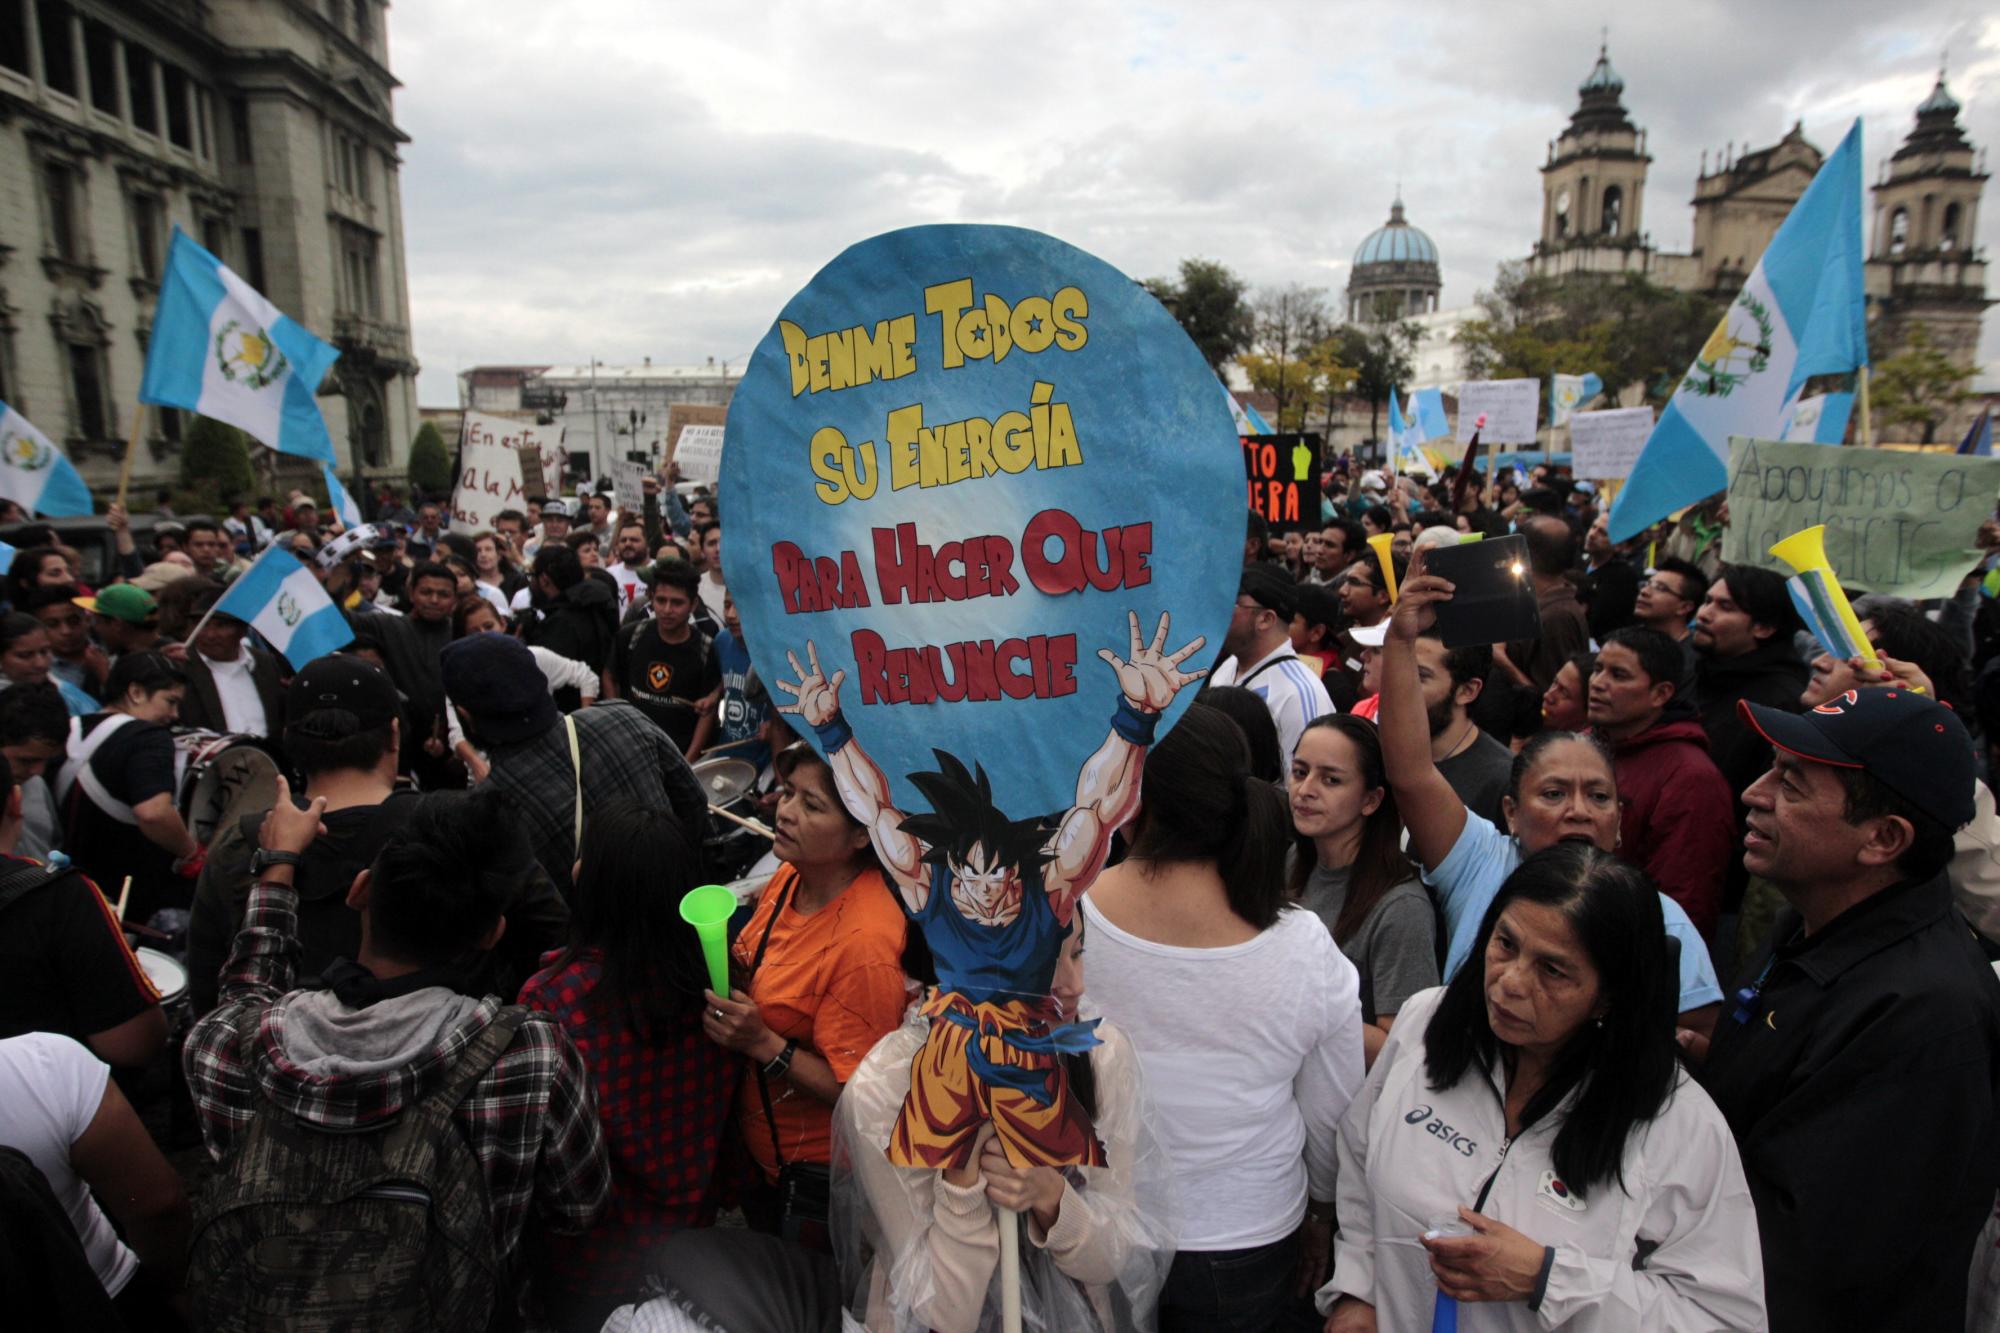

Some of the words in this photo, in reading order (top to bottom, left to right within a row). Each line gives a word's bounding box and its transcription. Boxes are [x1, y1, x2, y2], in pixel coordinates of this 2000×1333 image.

[780, 313, 917, 397] DENME
[924, 277, 1089, 369] TODOS
[809, 427, 879, 505] SU
[886, 381, 1084, 491] ENERGÍA
[1729, 438, 1912, 523] Apoyamos
[1936, 468, 1967, 512] a
[771, 541, 871, 614] PARA
[871, 522, 1020, 606] HACER
[1021, 509, 1153, 596] QUE
[851, 628, 1078, 705] RENUNCIE
[1425, 1118, 1478, 1158] asics
